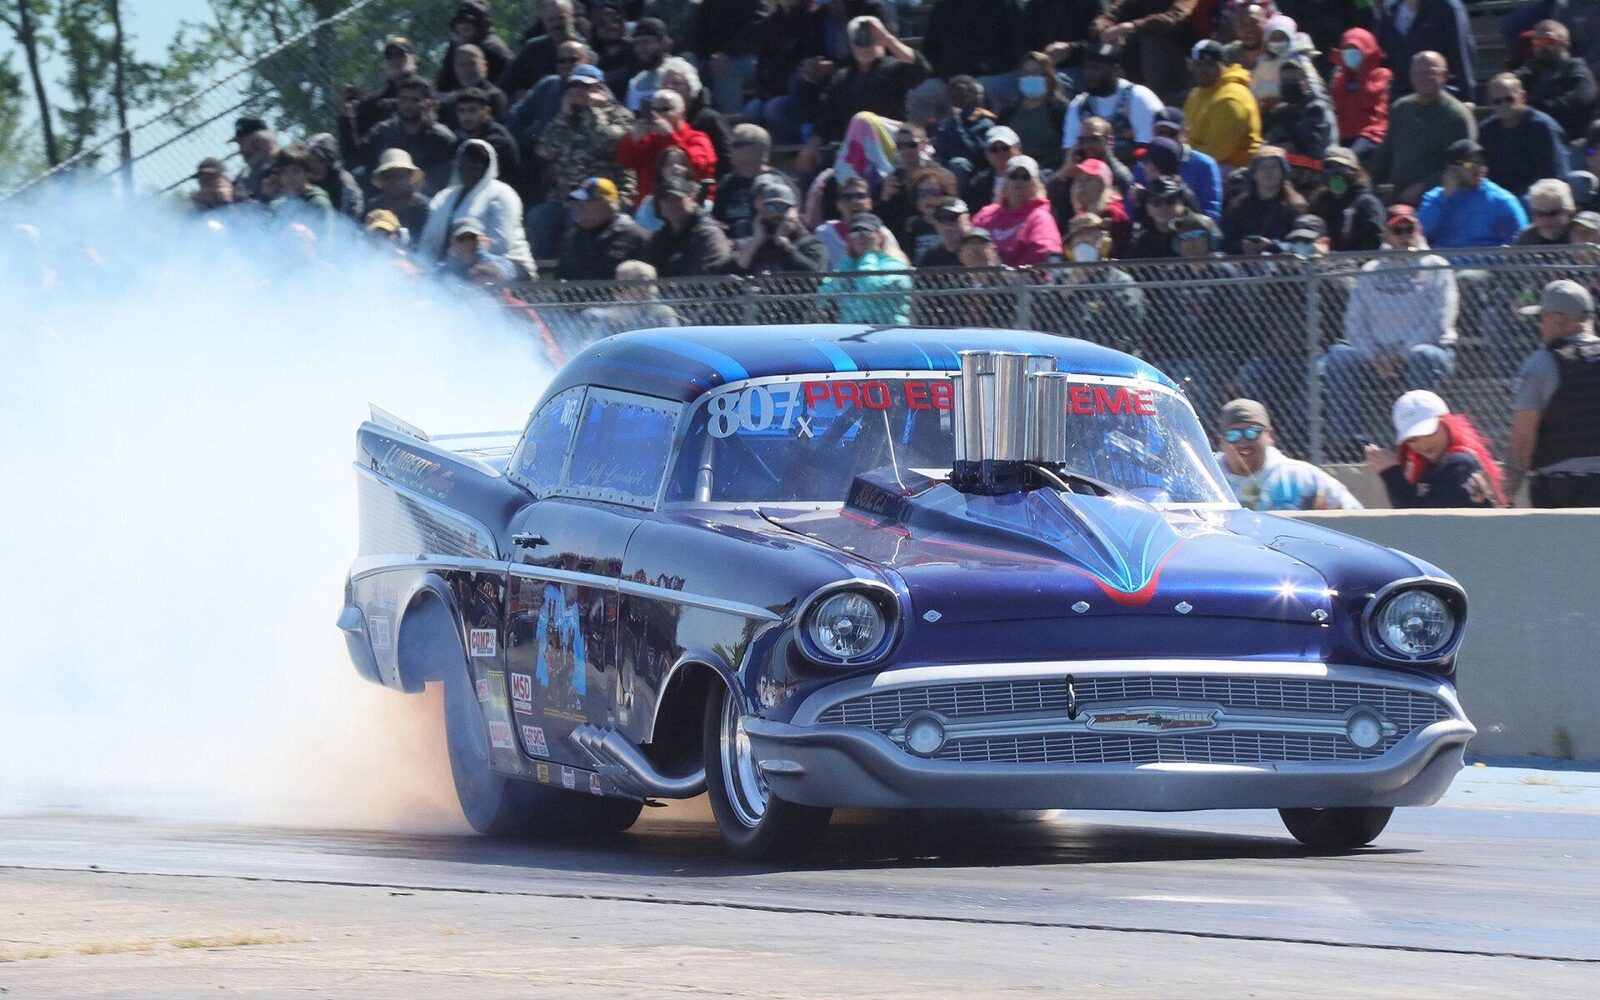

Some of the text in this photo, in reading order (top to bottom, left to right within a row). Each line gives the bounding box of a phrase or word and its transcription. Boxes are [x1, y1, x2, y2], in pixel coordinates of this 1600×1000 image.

[707, 383, 801, 438] 807
[803, 381, 892, 409] PRO
[1066, 386, 1156, 415] EME
[513, 675, 530, 699] MSD
